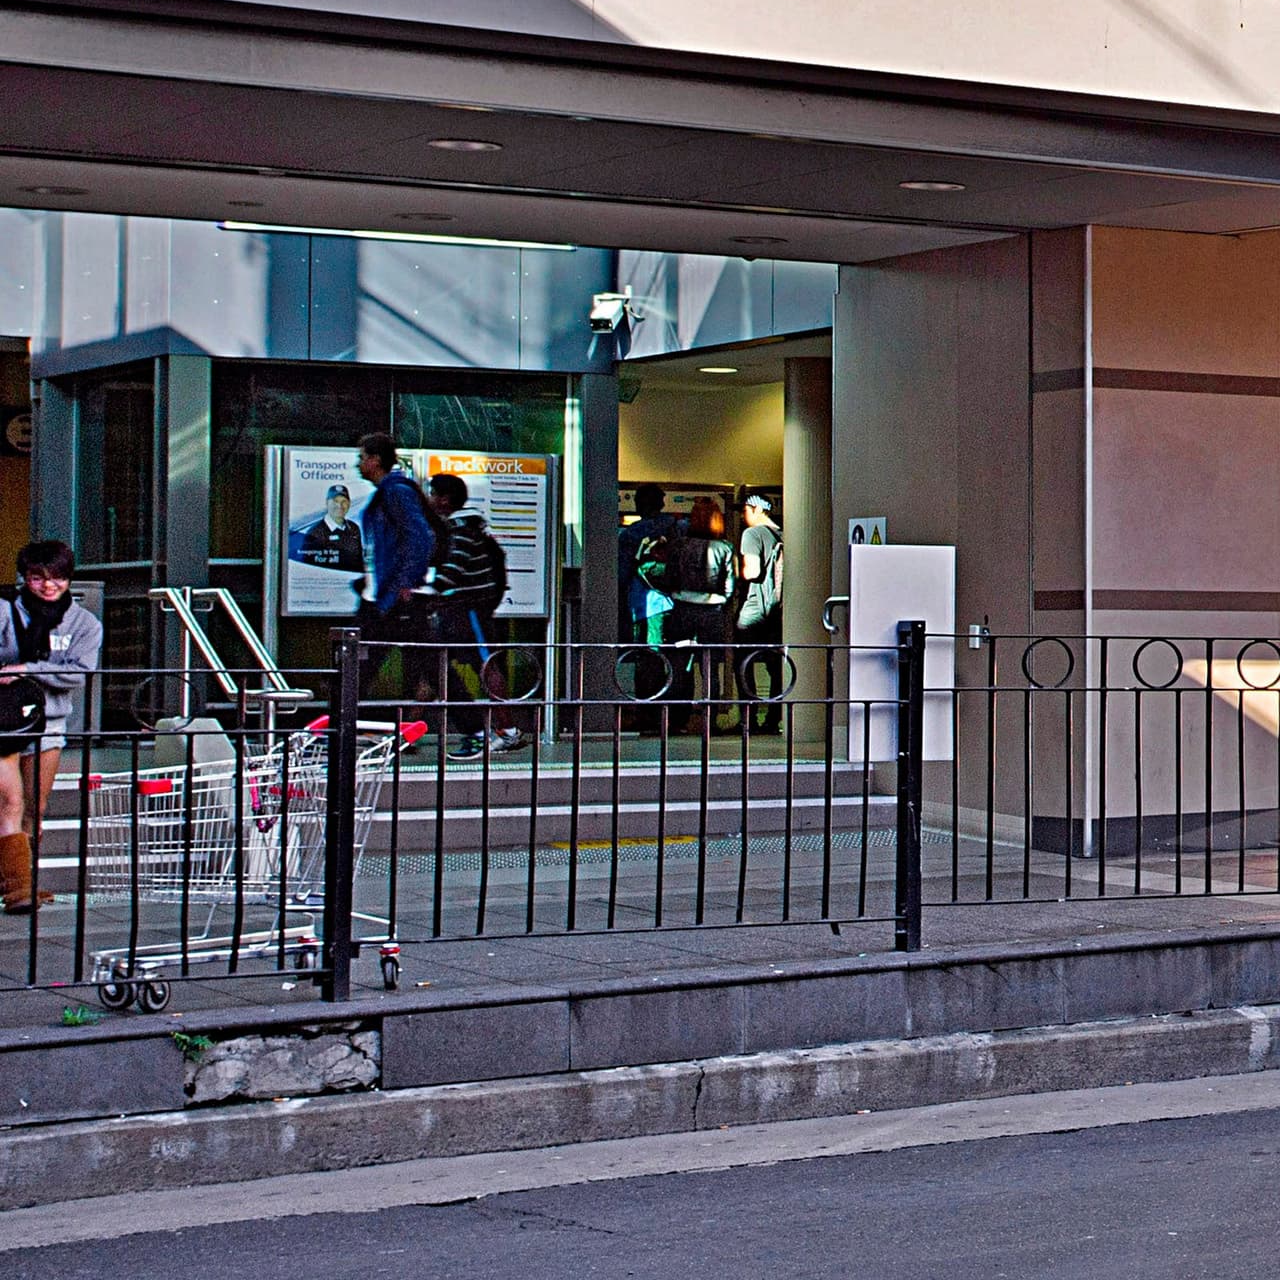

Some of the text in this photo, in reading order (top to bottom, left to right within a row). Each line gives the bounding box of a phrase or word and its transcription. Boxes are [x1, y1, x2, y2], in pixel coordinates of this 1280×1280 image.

[295, 460, 347, 471] Transport
[437, 455, 524, 474] Trackwork
[301, 470, 345, 481] Officers
